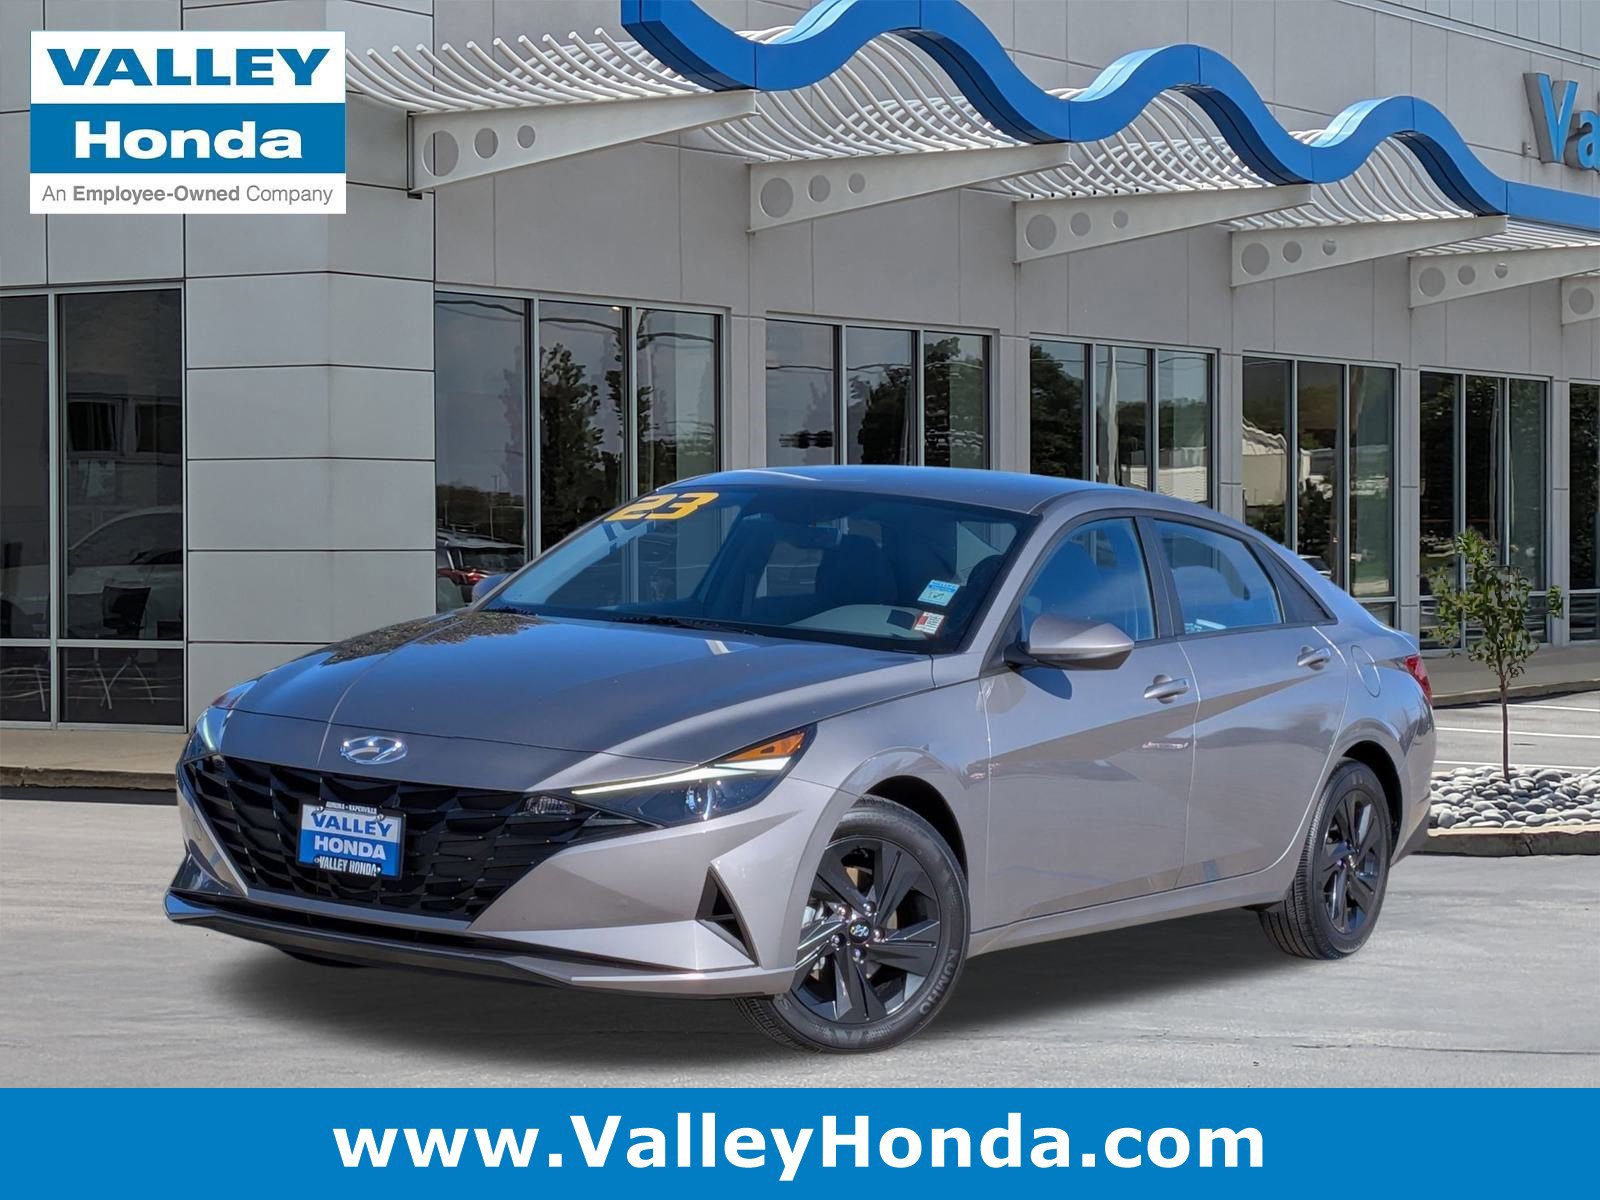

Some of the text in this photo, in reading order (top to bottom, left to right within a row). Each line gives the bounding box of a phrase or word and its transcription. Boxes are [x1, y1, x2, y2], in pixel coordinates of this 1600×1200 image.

[1523, 72, 1600, 172] Va
[604, 492, 719, 521] 23
[312, 814, 392, 837] VALLEY
[314, 835, 387, 860] HONDA
[319, 855, 377, 877] VALLEY HONDA
